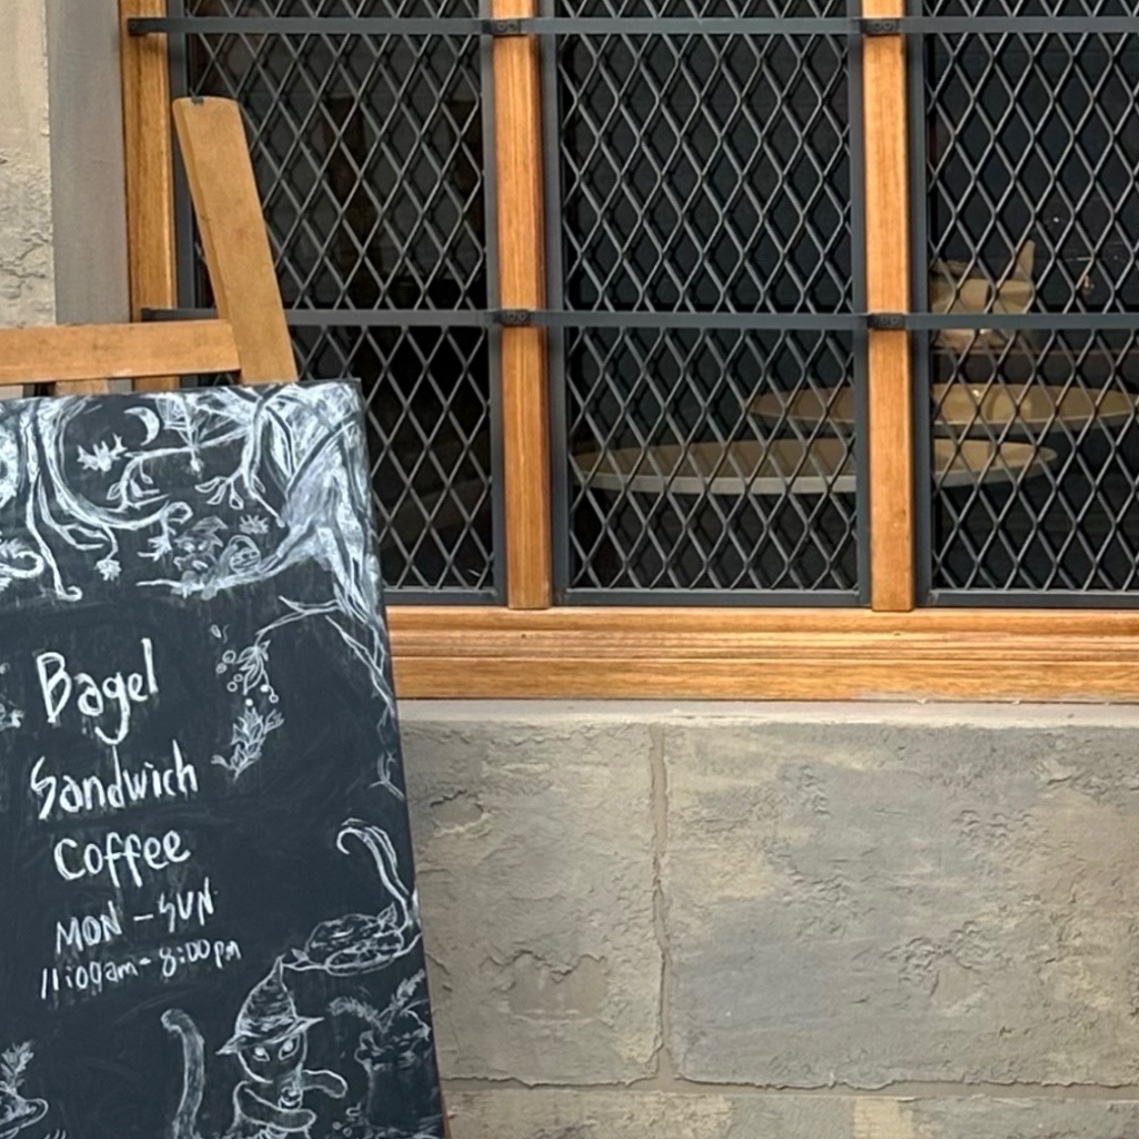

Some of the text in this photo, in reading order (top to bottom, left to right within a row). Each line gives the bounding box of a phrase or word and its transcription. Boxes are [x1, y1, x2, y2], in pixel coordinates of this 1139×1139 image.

[36, 637, 159, 745] Bagel
[30, 739, 198, 820] Sandwich
[54, 829, 191, 888] Coffee
[56, 900, 123, 955] MON
[158, 876, 214, 933] SUN
